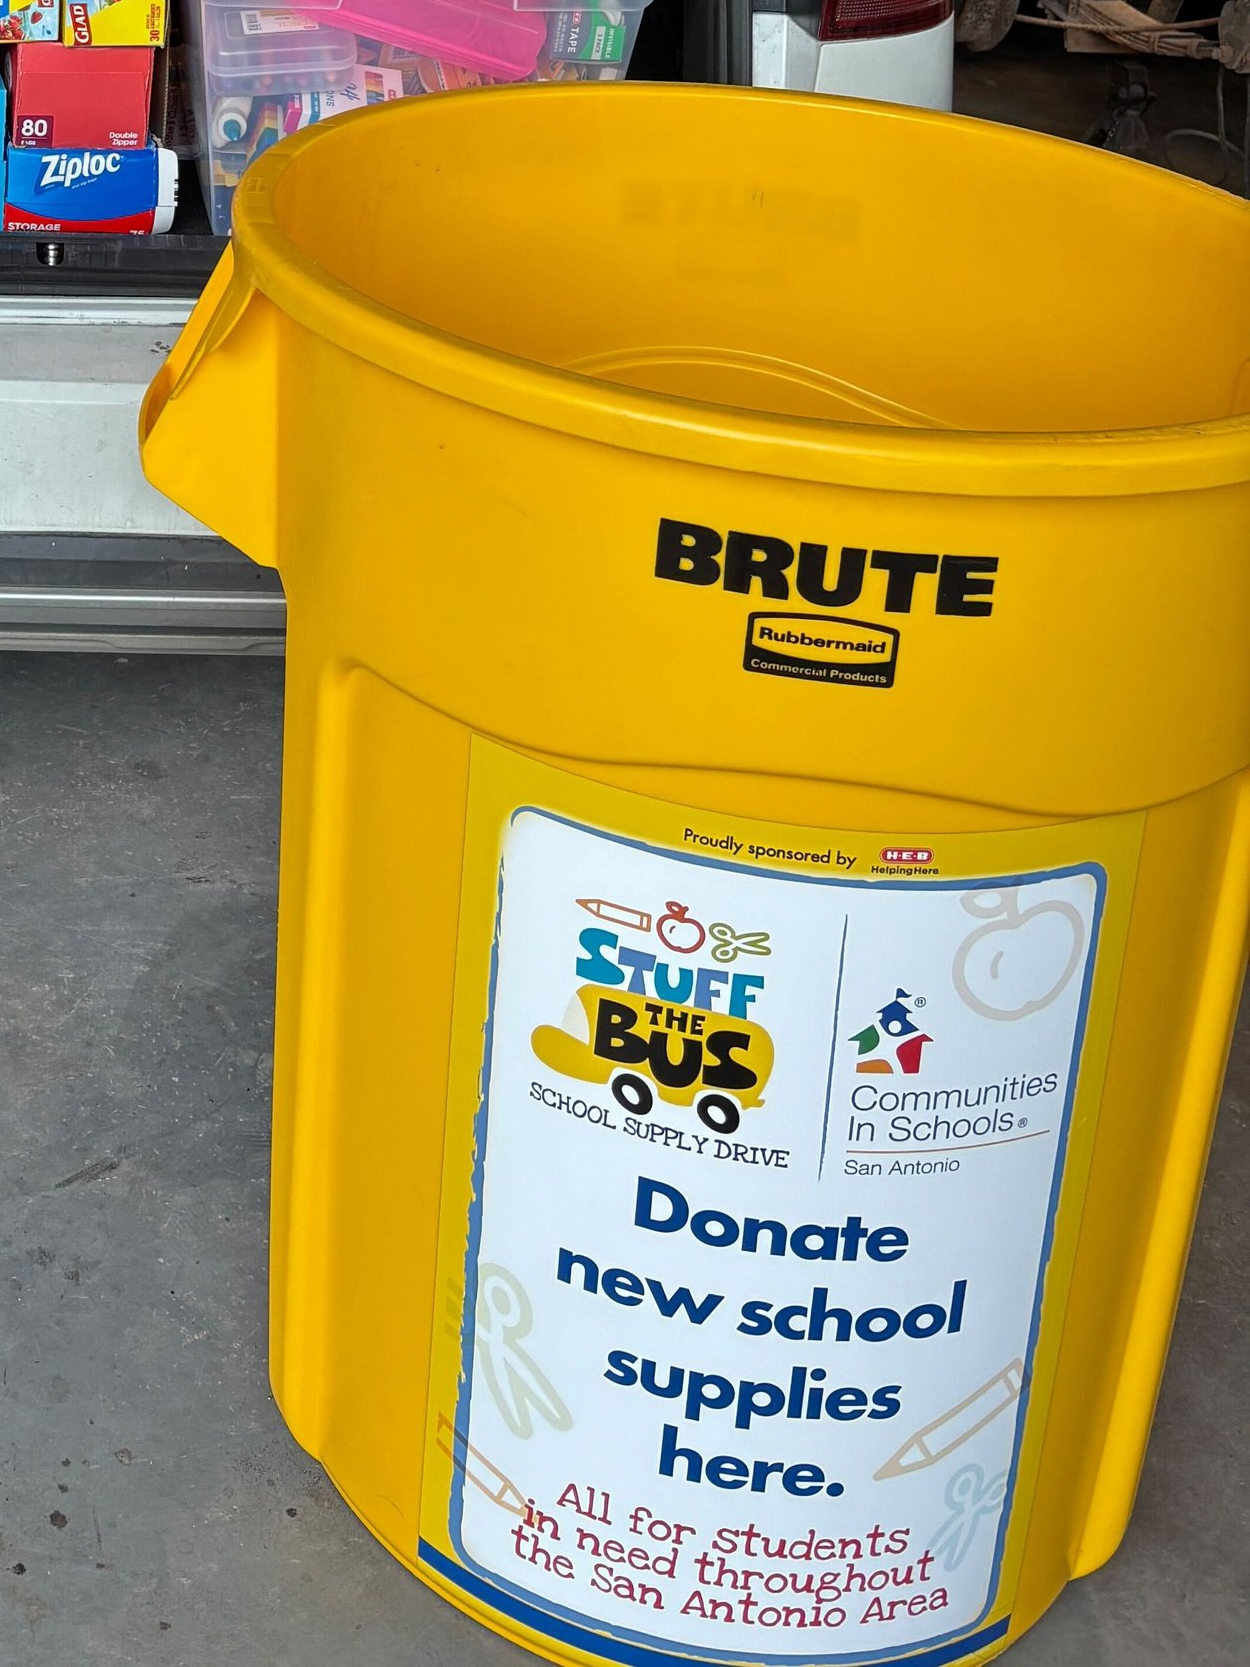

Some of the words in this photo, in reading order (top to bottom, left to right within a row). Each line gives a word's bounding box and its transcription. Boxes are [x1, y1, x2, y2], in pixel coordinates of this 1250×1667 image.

[74, 6, 89, 43] GLAD
[150, 30, 160, 41] 30
[568, 27, 580, 54] TAPE
[21, 119, 48, 136] 80
[40, 152, 121, 187] Ziploc
[8, 222, 61, 231] STORAGE
[654, 517, 999, 617] BRUTE
[759, 626, 886, 654] Rubbermaid
[750, 658, 826, 678] Commercial
[830, 669, 888, 684] Products
[684, 828, 744, 854] Proudly
[748, 844, 831, 864] sponsored
[836, 850, 857, 870] by
[576, 928, 765, 1020] STUFF
[644, 1002, 706, 1036] THE
[594, 998, 758, 1090] BUS
[850, 1073, 1058, 1112] Communities
[529, 1082, 616, 1130] SCHOOL
[623, 1117, 710, 1154] SUPPLY
[714, 1139, 790, 1168] DRIVE
[848, 1116, 876, 1142] In
[844, 1160, 882, 1176] San
[888, 1158, 960, 1176] Antonio
[634, 1175, 910, 1262] Donate
[556, 1247, 725, 1325] new
[736, 1280, 968, 1342] school
[603, 1350, 902, 1430] supplies
[658, 1423, 845, 1498] here.
[556, 1482, 612, 1526] All
[629, 1506, 697, 1547] for
[712, 1522, 911, 1562] students
[523, 1498, 560, 1541] in
[576, 1522, 678, 1580] need
[694, 1549, 936, 1603] throughout
[510, 1524, 576, 1580] the
[590, 1562, 666, 1611] San
[680, 1590, 848, 1630] Antonio
[859, 1587, 949, 1624] Area
